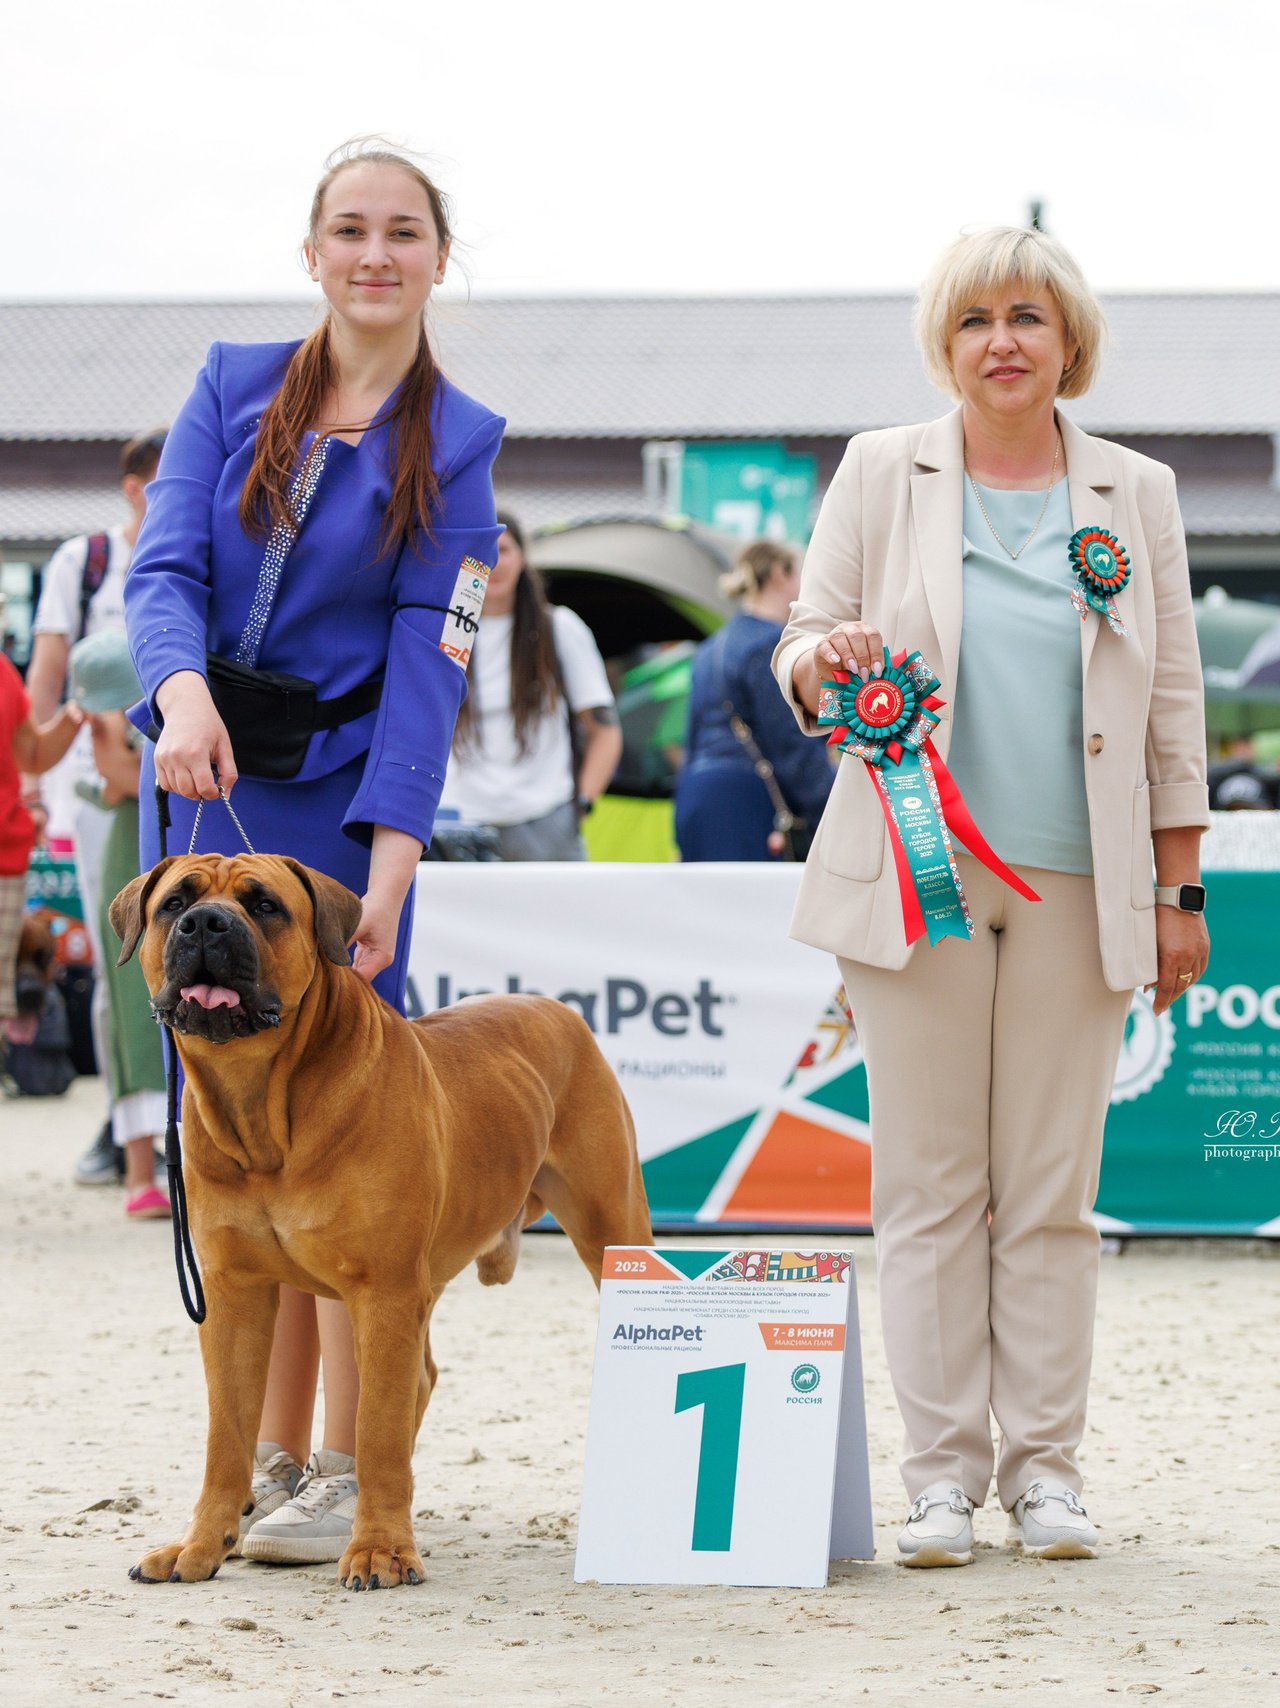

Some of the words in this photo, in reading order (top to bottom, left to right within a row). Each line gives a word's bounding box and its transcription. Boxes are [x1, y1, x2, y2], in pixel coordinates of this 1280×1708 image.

[900, 808, 931, 817] РОССИЯ
[905, 819, 932, 828] МОСКВЫ
[911, 832, 932, 840] КУБОК
[914, 843, 935, 852] ГЕРОЕВ
[920, 850, 933, 858] 2025
[916, 871, 949, 884] ПОБЕДИТЕЛЬ
[924, 880, 945, 889] КЛАССА
[614, 1261, 647, 1273] 2025
[612, 1324, 703, 1344] AlphaPet
[772, 1328, 780, 1337] 7
[787, 1328, 795, 1337] 8
[797, 1328, 834, 1338] ИЮНЯ
[786, 1396, 822, 1405] РОССИЯ
[674, 1362, 746, 1552] 1
